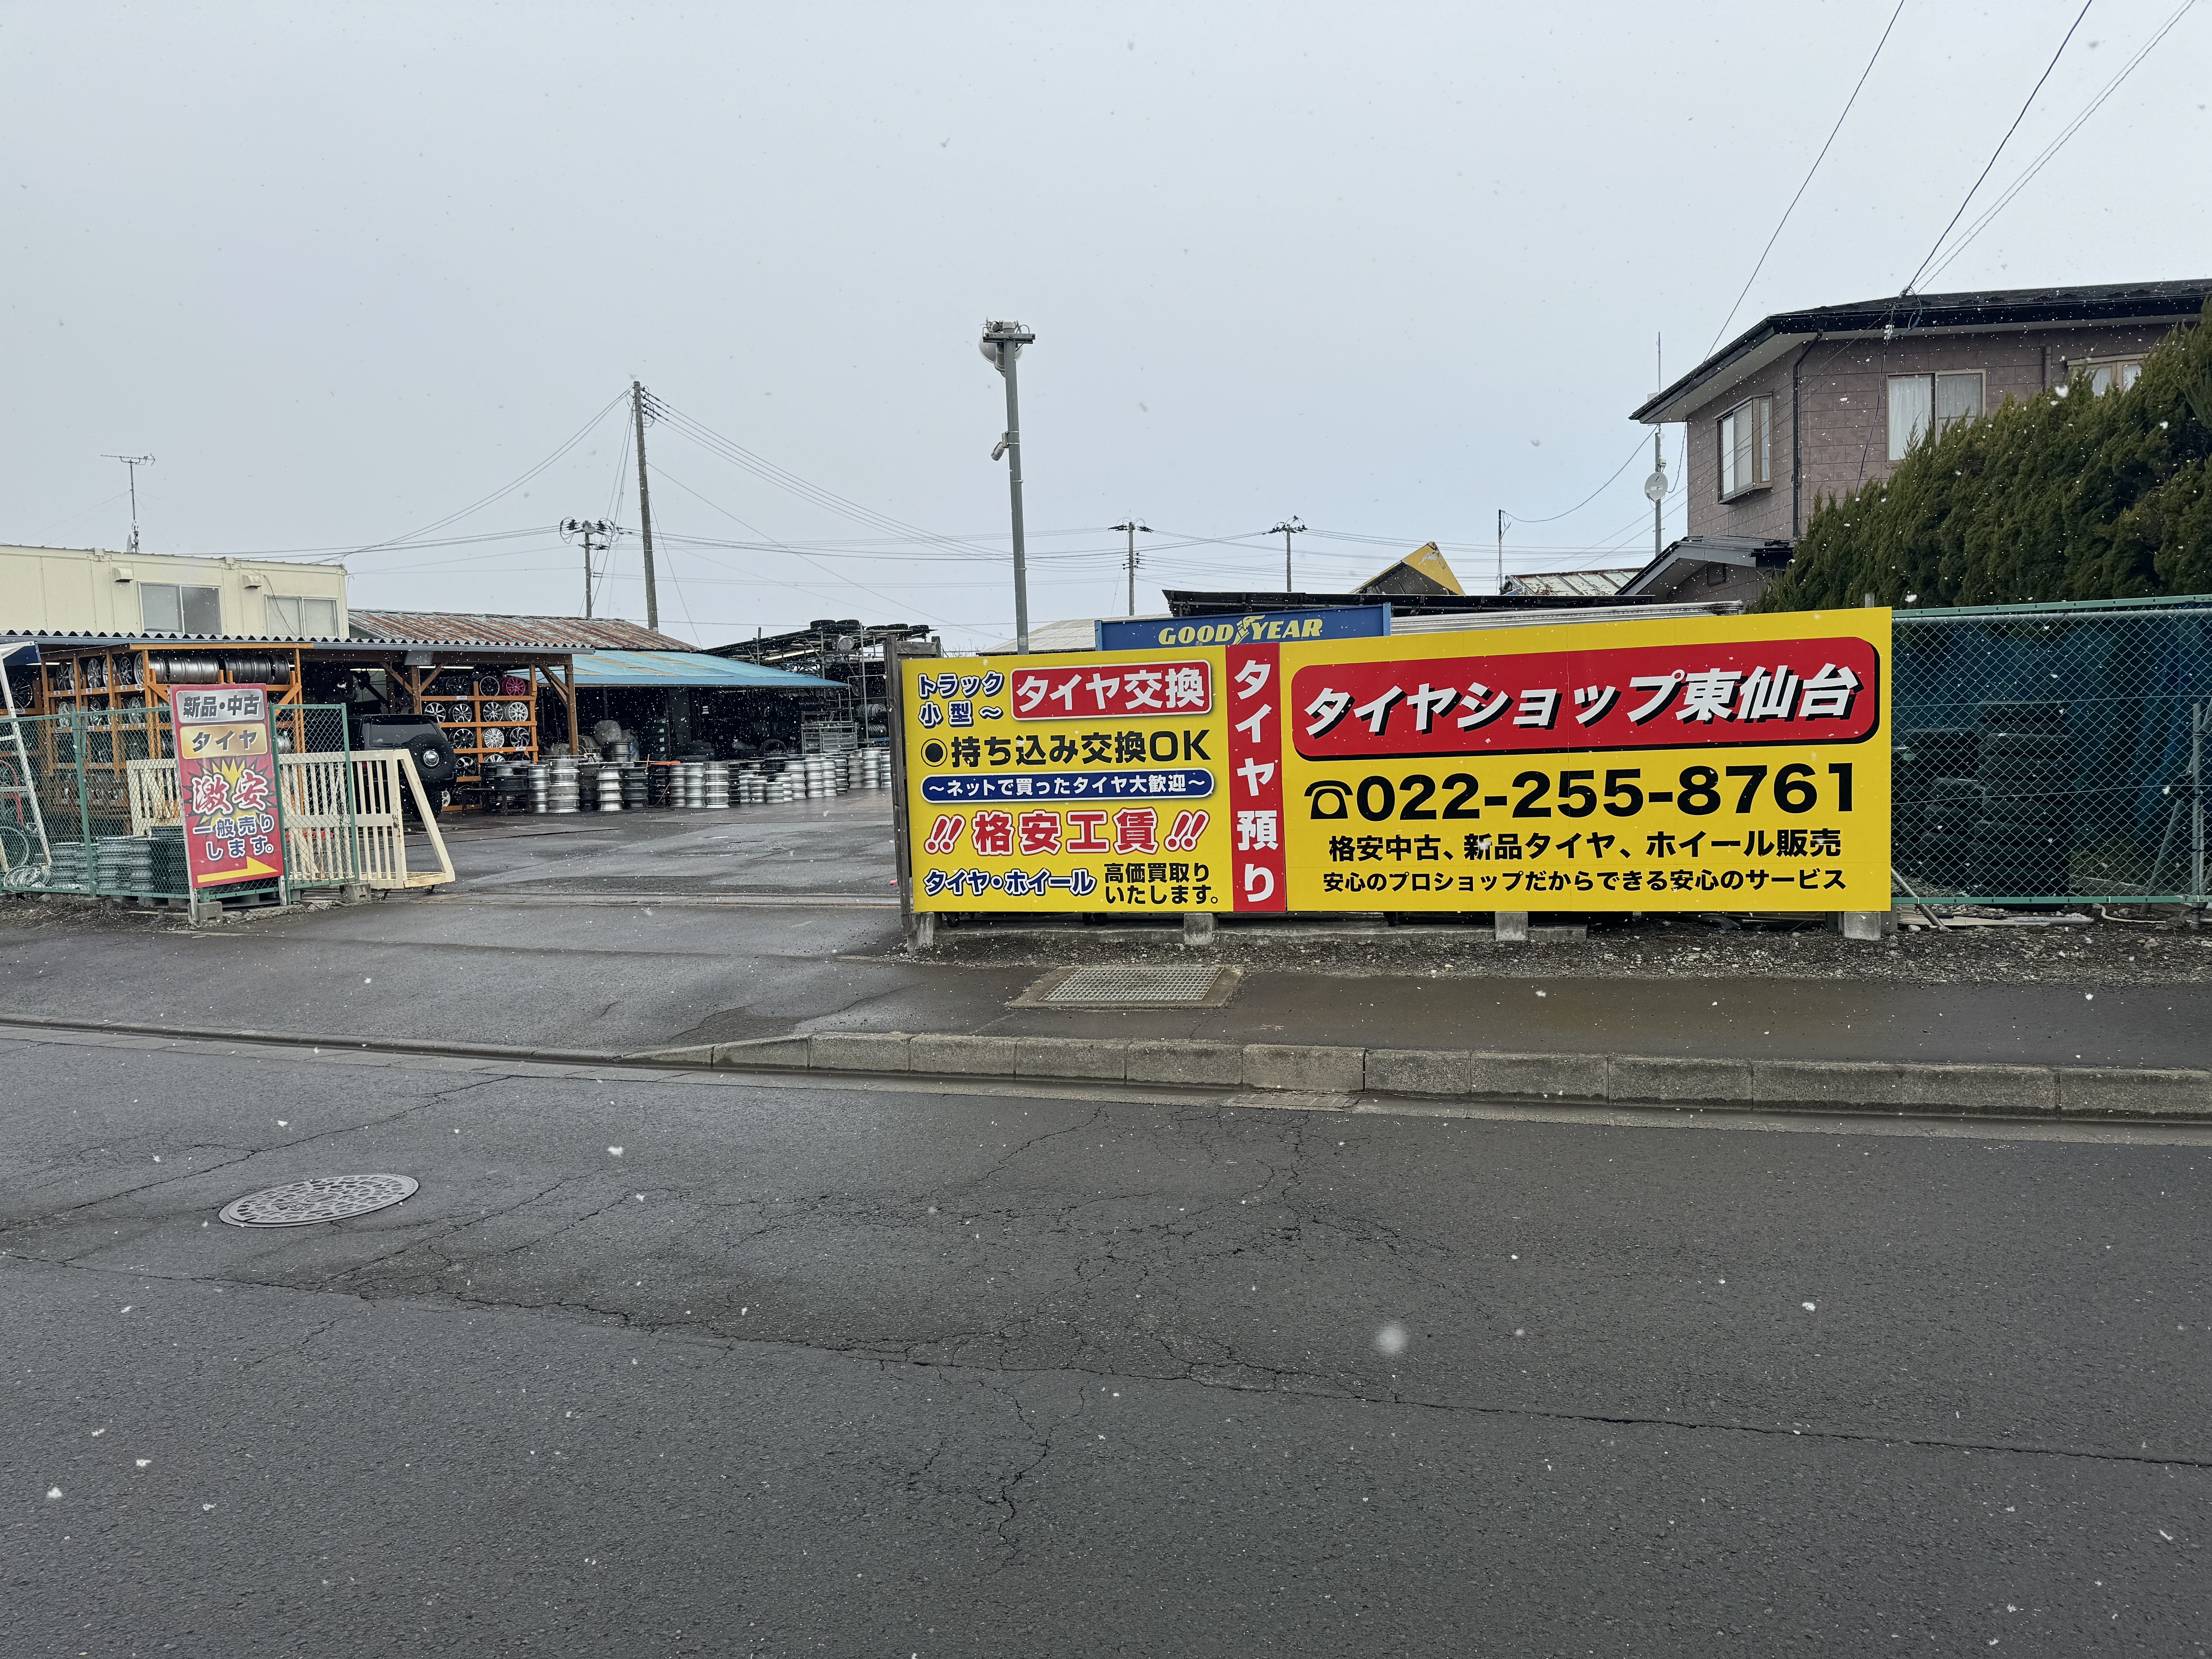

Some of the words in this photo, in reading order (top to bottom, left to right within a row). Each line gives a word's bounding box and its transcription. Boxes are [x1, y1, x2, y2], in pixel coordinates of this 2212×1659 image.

[1159, 618, 1323, 645] GOODYEAR
[918, 671, 1005, 699] トラック
[1016, 668, 1205, 713] タイヤ交換
[183, 696, 260, 718] 新品・中古
[1304, 661, 1861, 740] タイヤショップ東仙台
[192, 729, 258, 752] タイヤ
[192, 769, 269, 815] 激安
[1235, 659, 1278, 903] タイヤ預り
[1355, 762, 1853, 822] 022-255-8761
[192, 814, 275, 840] 一般売り
[205, 836, 275, 862] します。
[1328, 828, 1842, 863] 格安中古、新品タイヤ、ホイール販売
[923, 867, 1097, 898] タイヤ・ホイール
[1103, 862, 1210, 884] 高価買取り
[1322, 867, 1846, 893] 安心のプロショップだからできる安心のサービス
[1105, 884, 1219, 905] いたします。
